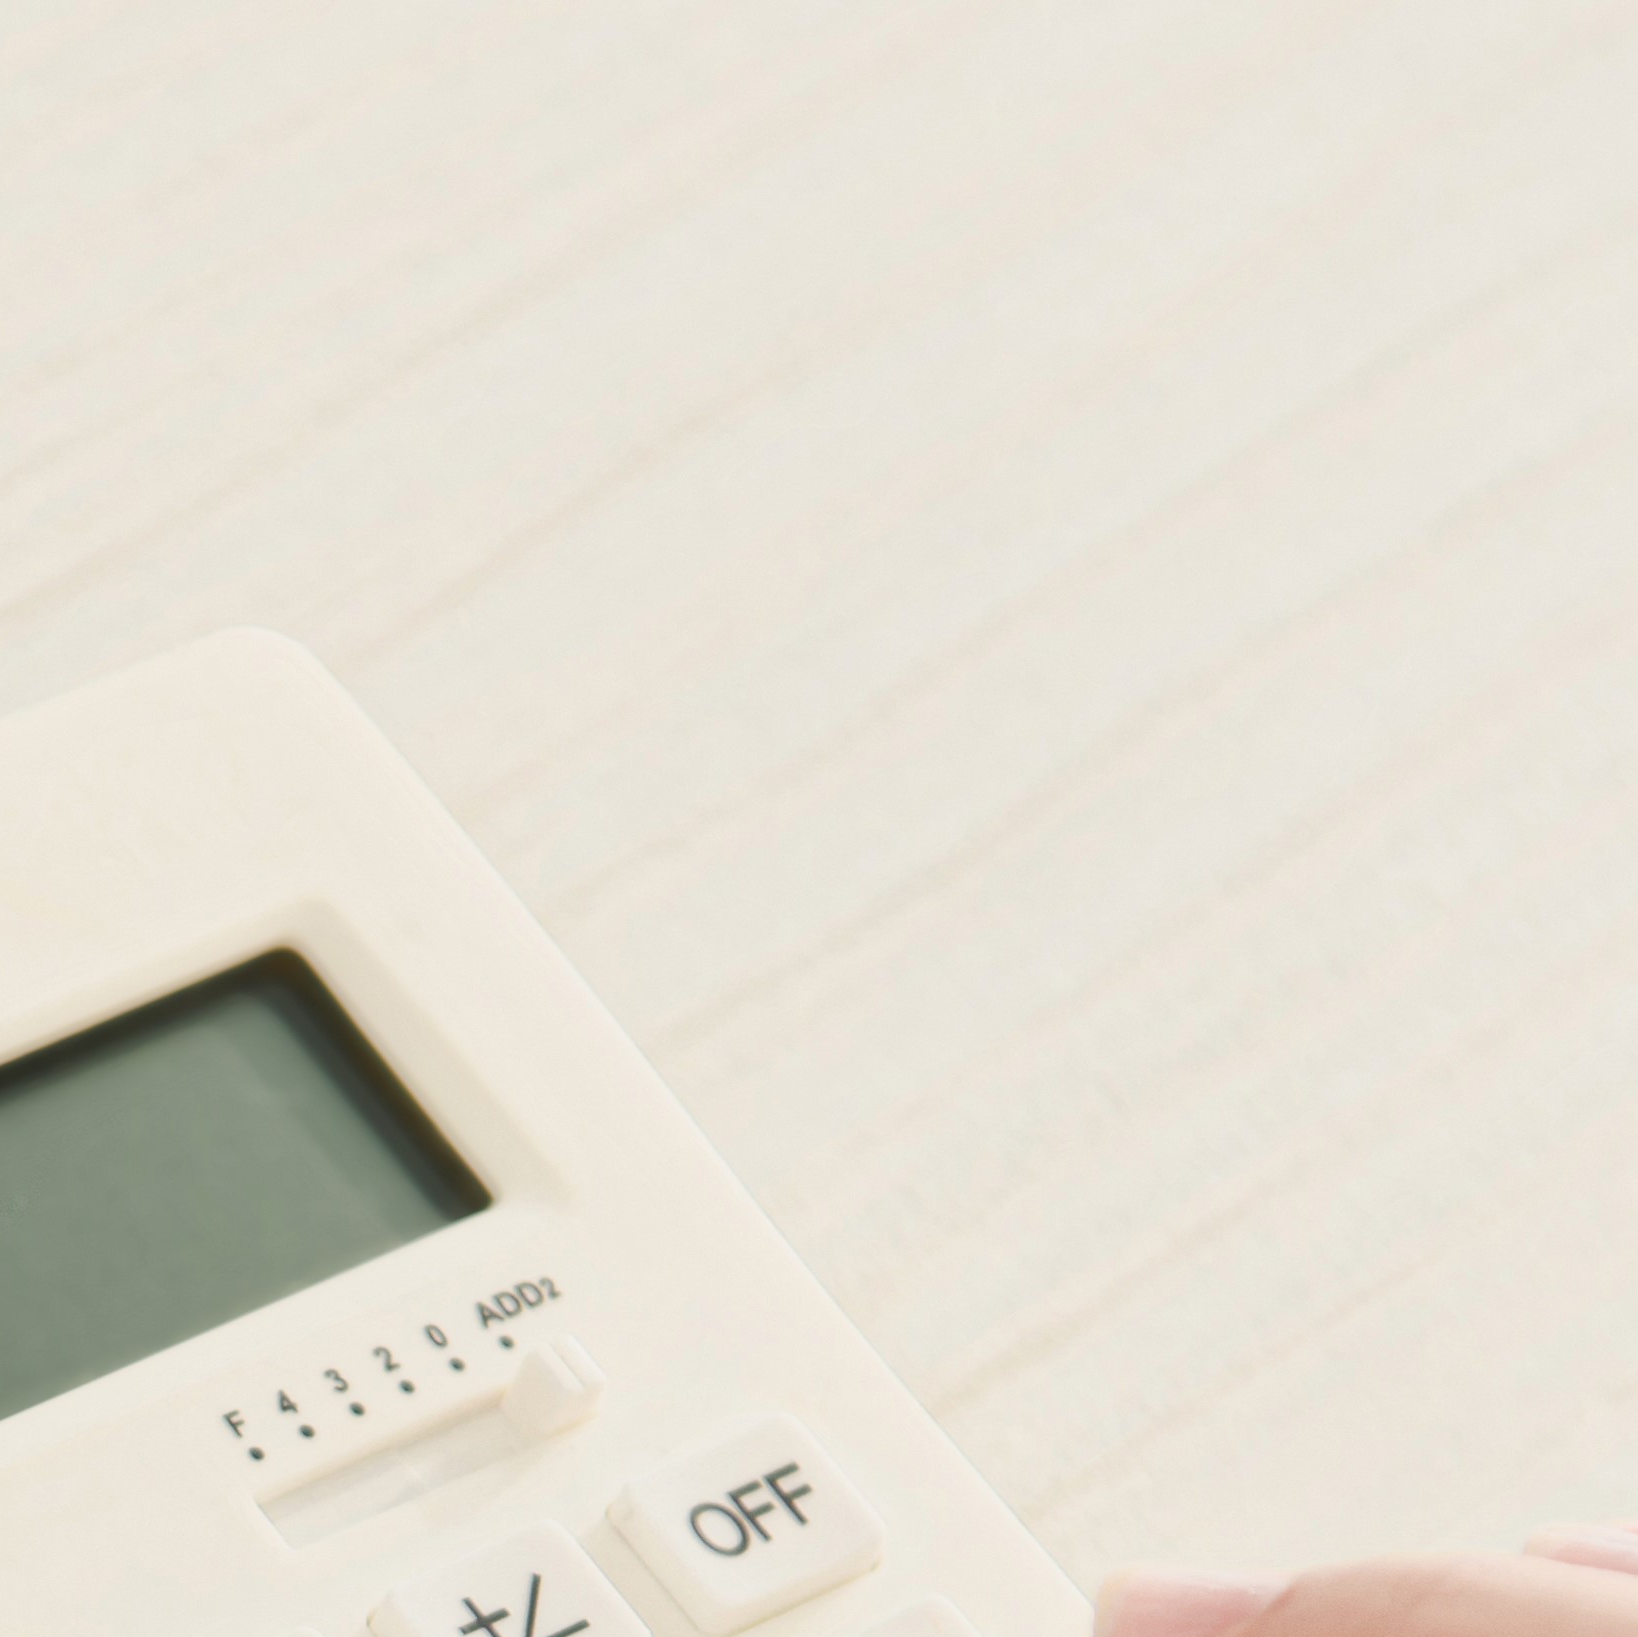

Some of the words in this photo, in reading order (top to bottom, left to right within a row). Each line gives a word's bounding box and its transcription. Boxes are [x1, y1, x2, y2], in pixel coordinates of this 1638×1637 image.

[222, 1409, 245, 1439] F
[277, 1389, 299, 1415] 4
[323, 1368, 350, 1394] 3
[372, 1346, 401, 1373] 2
[423, 1324, 449, 1349] 0
[688, 1462, 812, 1558] OFF
